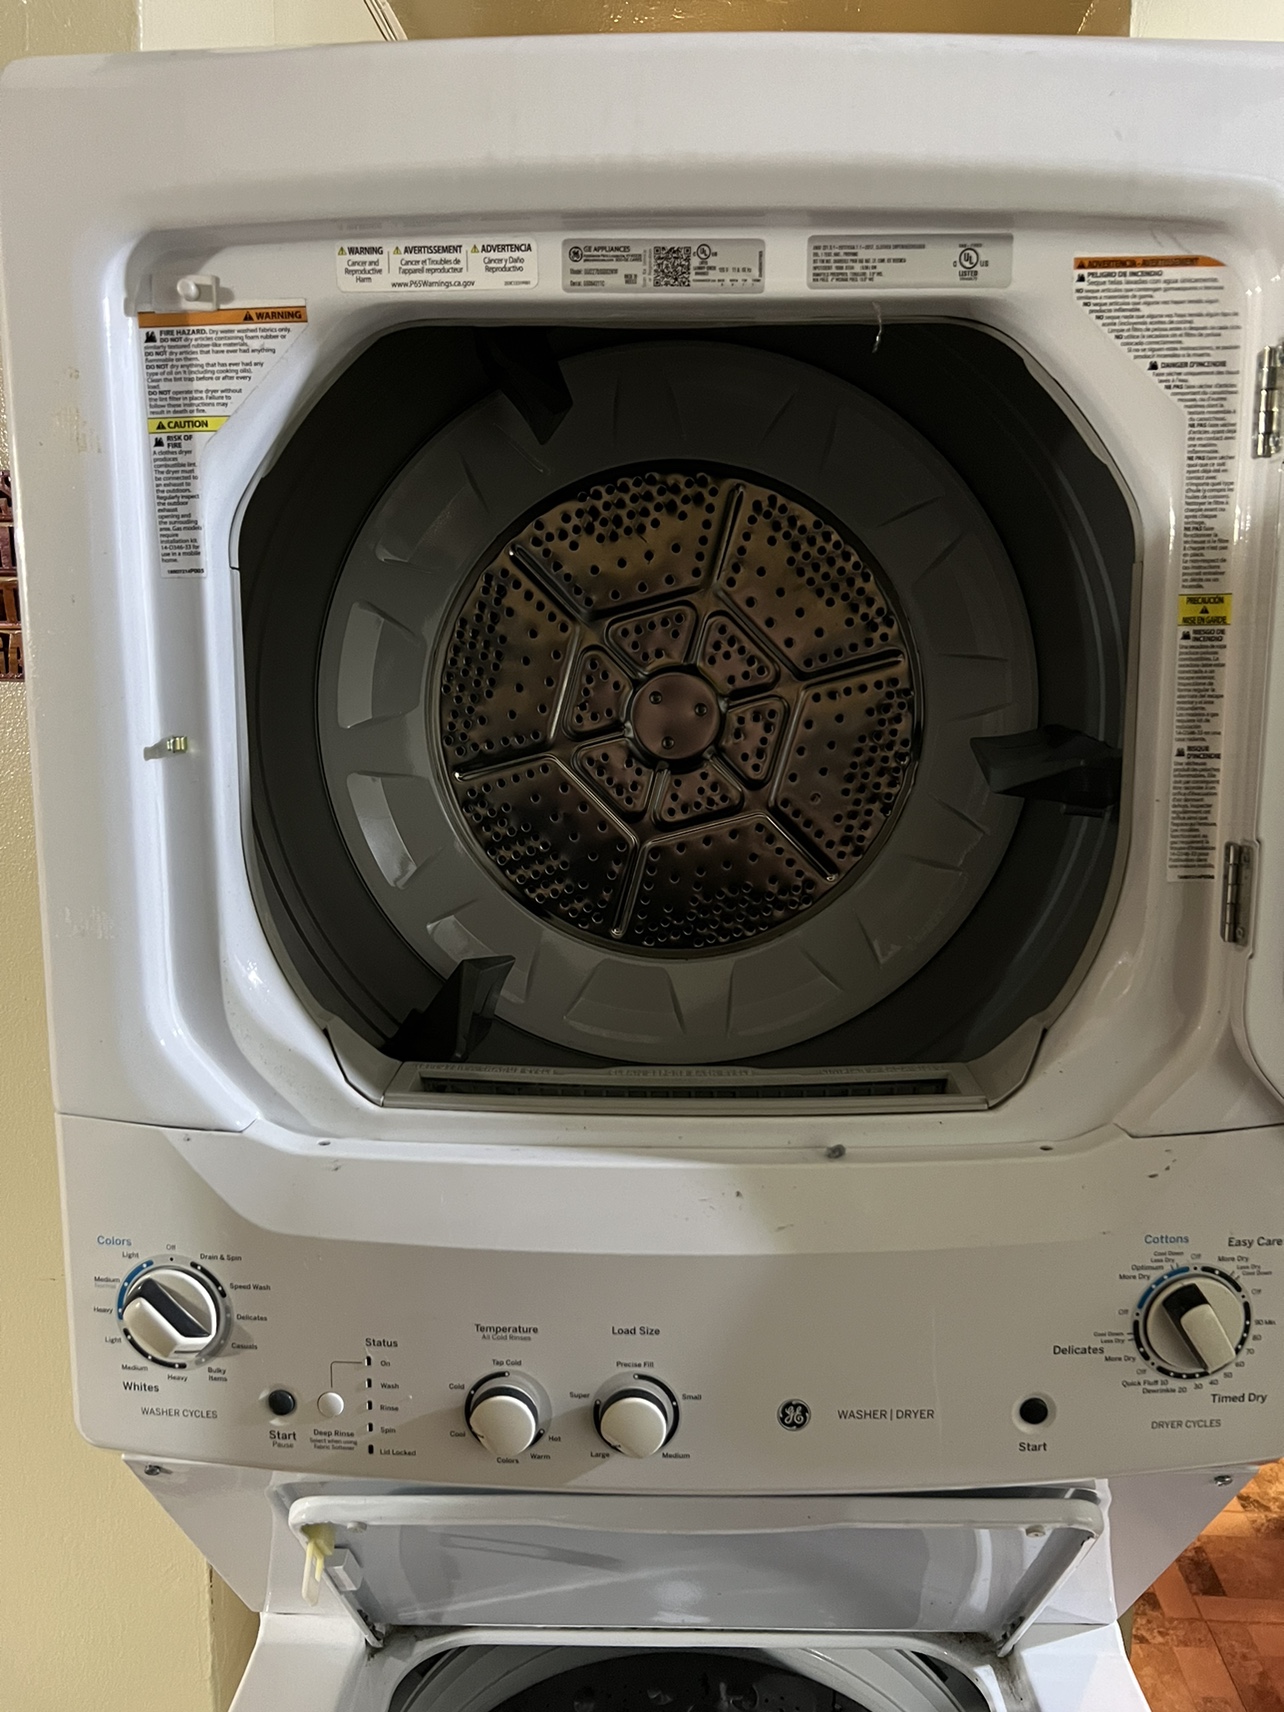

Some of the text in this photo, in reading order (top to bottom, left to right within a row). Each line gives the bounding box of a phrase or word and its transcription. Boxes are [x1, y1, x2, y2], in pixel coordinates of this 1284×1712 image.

[347, 246, 383, 255] WARNING
[404, 245, 462, 255] AVERTISSEMENT
[481, 243, 532, 253] ADVERTENCIA
[347, 258, 379, 267] Cancer and
[400, 257, 461, 266] Cancer et Troubles de
[483, 256, 503, 264] Cáncer
[508, 255, 525, 264] Daño
[345, 267, 382, 276] Reproductive
[399, 265, 463, 276] l'appareil reproducteur
[484, 265, 524, 274] Reproductivo
[391, 280, 475, 288] www.P65Warnings.ca.gov
[255, 311, 302, 320] WARNING
[176, 328, 208, 336] HAZARD.
[214, 334, 244, 342] containing
[167, 420, 208, 429] CAUTION
[97, 1235, 132, 1246] Colors
[1144, 1235, 1189, 1244] Cottons
[1228, 1236, 1283, 1248] Easy Care
[122, 1251, 139, 1259] Light
[226, 1254, 242, 1262] Spin
[1237, 1255, 1249, 1263] Dry
[1138, 1273, 1150, 1281] Dry
[230, 1283, 251, 1291] Speed
[93, 1307, 113, 1315] Heavy
[236, 1314, 267, 1322] Delicates
[475, 1323, 539, 1336] Temperature
[611, 1326, 660, 1336] Load Size
[365, 1338, 398, 1347] Status
[1053, 1345, 1104, 1355] Delicates
[492, 1359, 504, 1367] Tap
[208, 1367, 226, 1375] Bulky
[167, 1374, 188, 1382] Heavy
[123, 1381, 159, 1392] Whites
[1121, 1380, 1141, 1388] Quick
[1211, 1393, 1267, 1404] Timed Dry
[380, 1404, 399, 1412] Rinse
[141, 1407, 218, 1419] WASHER CYCLES
[837, 1409, 934, 1419] WASHER DRYER
[1151, 1419, 1221, 1429] DRYER CYCLES
[269, 1430, 296, 1440] Start
[313, 1429, 354, 1438] Deep Rinse
[1018, 1442, 1047, 1452] Start
[590, 1451, 610, 1459] Large
